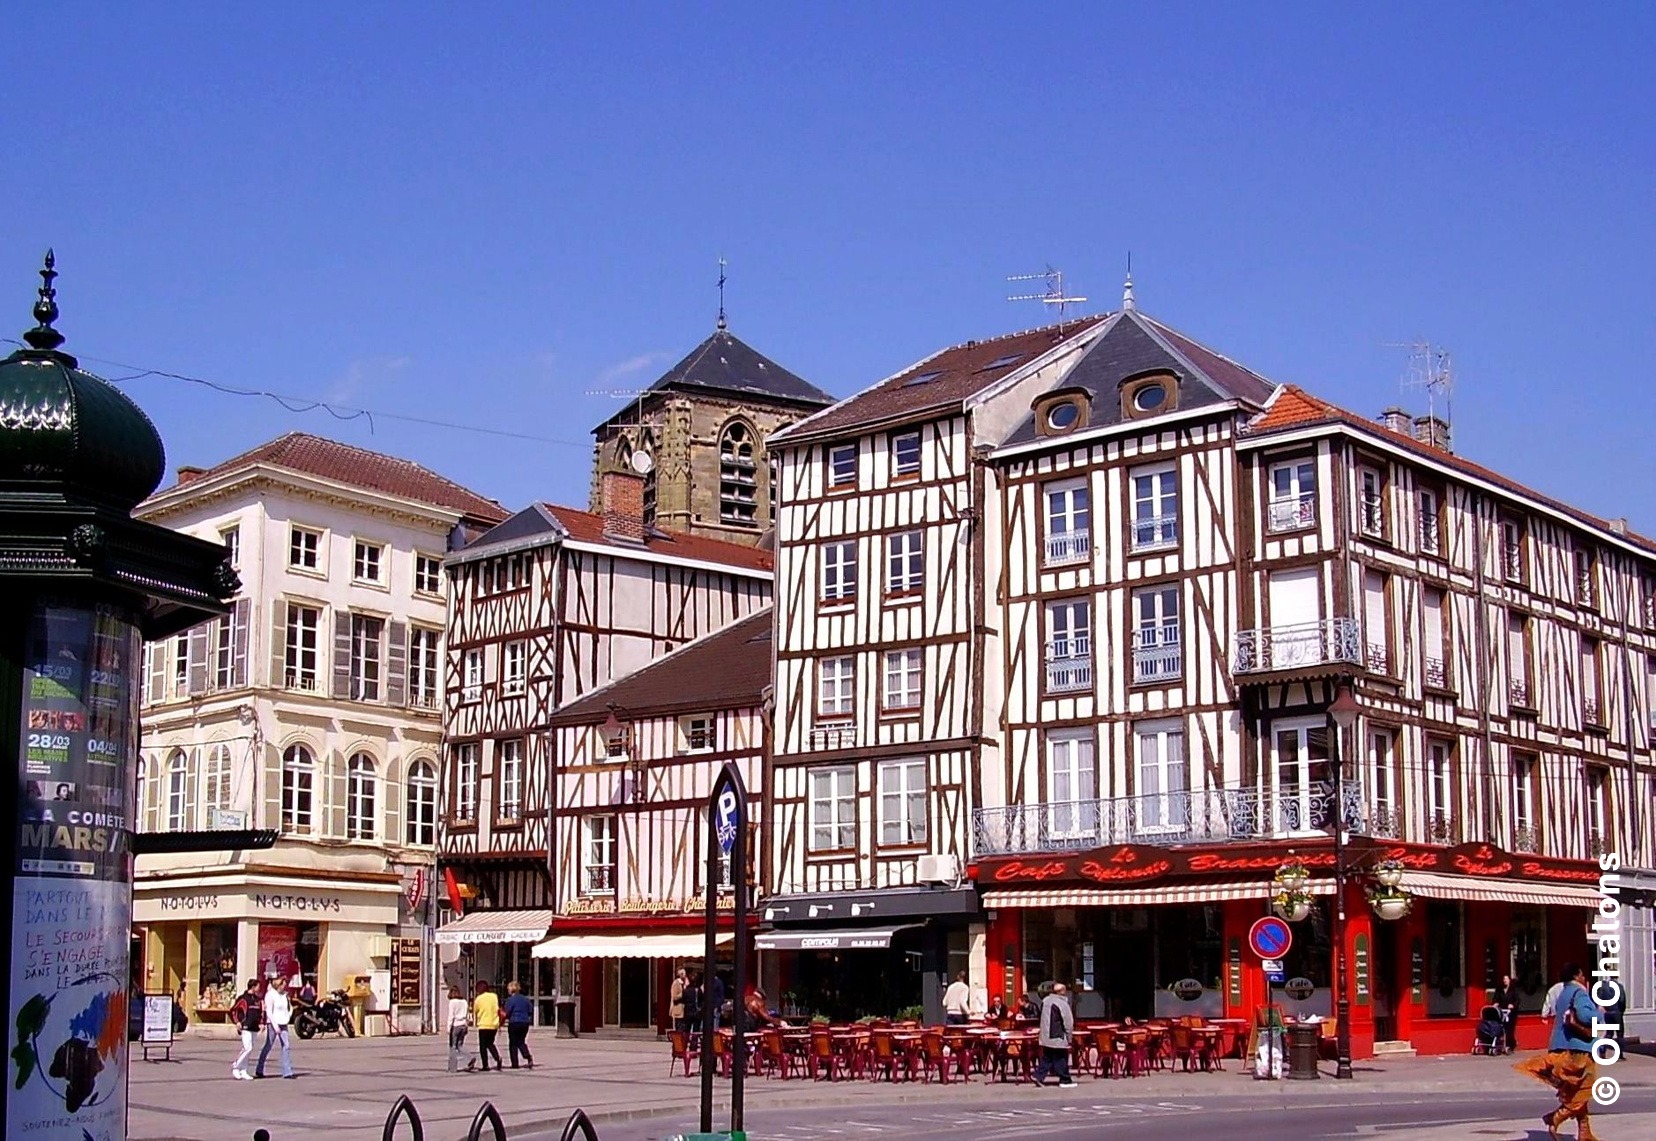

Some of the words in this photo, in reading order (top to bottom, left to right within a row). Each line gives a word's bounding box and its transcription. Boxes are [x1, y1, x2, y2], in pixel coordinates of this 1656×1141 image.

[28, 734, 71, 748] 28/03
[719, 791, 736, 826] P
[67, 810, 125, 828] COMÈTE
[26, 908, 68, 924] DANS
[26, 932, 44, 947] LE
[27, 945, 104, 968] S'ENGAGE
[25, 967, 50, 980] DANS
[57, 964, 69, 975] LA
